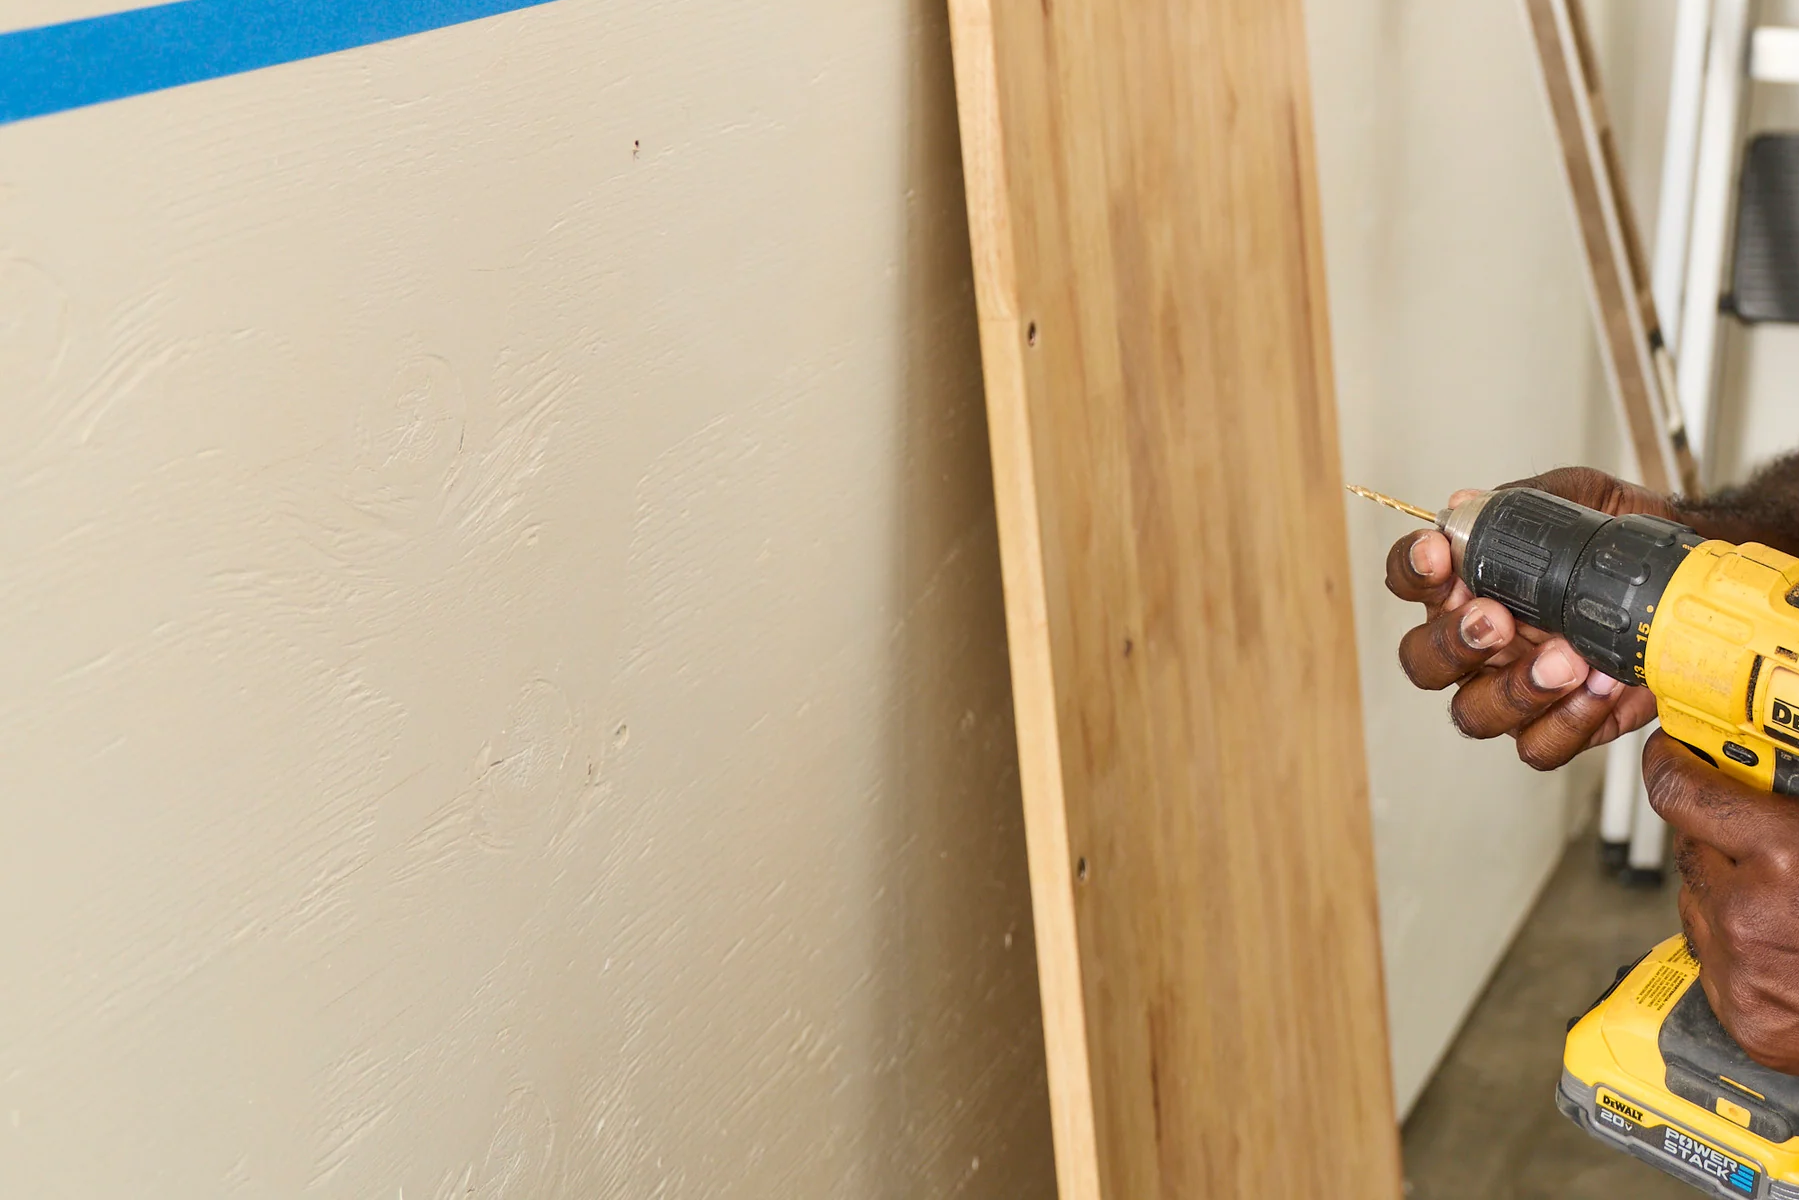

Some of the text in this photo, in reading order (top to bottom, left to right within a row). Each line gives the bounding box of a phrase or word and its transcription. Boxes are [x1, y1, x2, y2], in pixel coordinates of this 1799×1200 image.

[1636, 621, 1650, 643] 15
[1663, 1139, 1729, 1181] STACK
[1665, 1127, 1738, 1172] POWER
